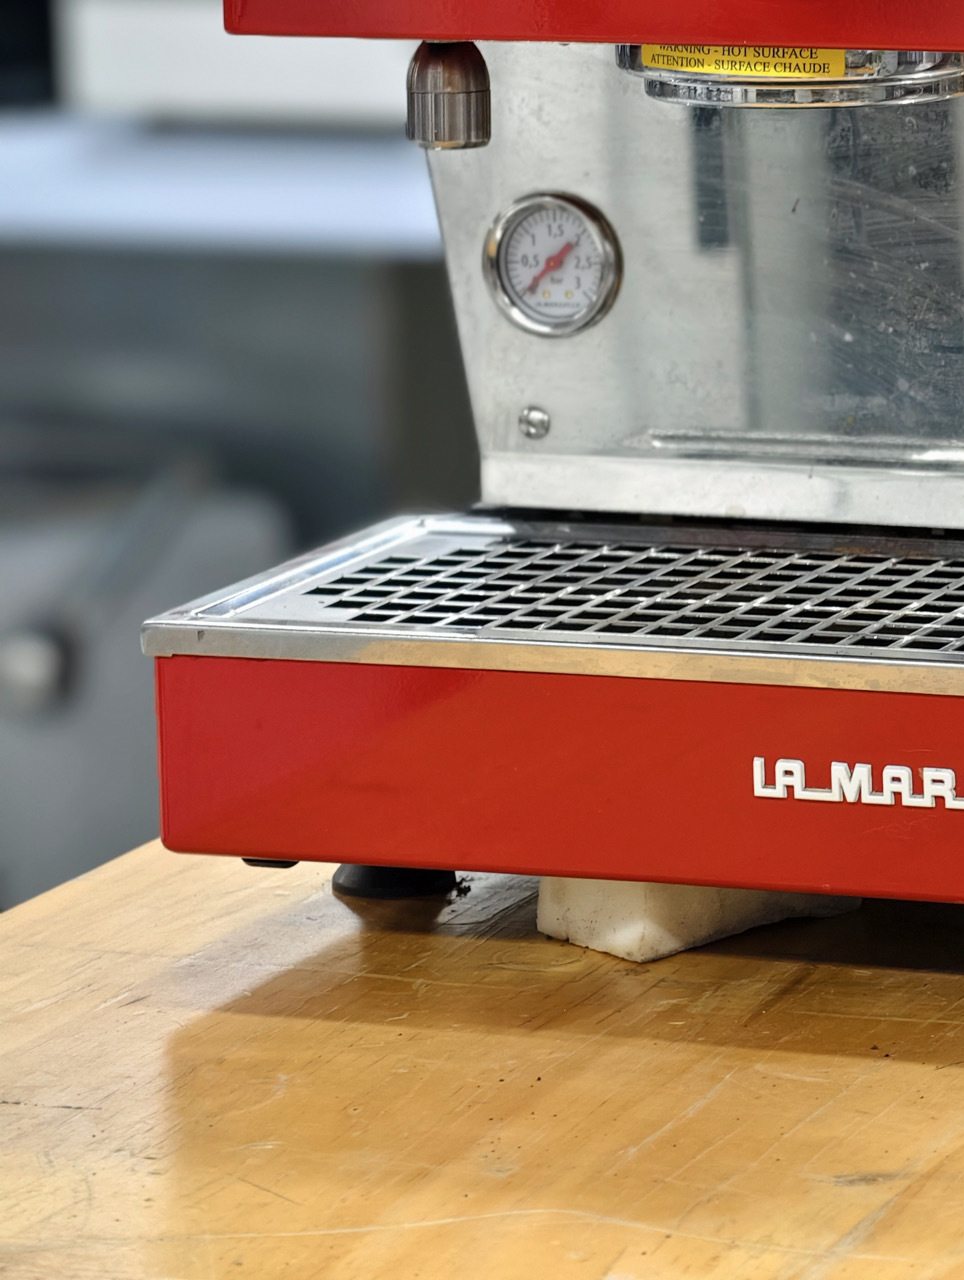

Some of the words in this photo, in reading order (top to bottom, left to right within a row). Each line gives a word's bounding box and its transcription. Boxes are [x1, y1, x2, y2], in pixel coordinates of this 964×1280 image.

[722, 46, 748, 57] HOT
[753, 47, 819, 59] SURFACE
[651, 53, 705, 68] ATTENTION
[714, 59, 771, 72] SURFACE
[774, 61, 831, 74] CHAUDE
[753, 756, 805, 799] LA
